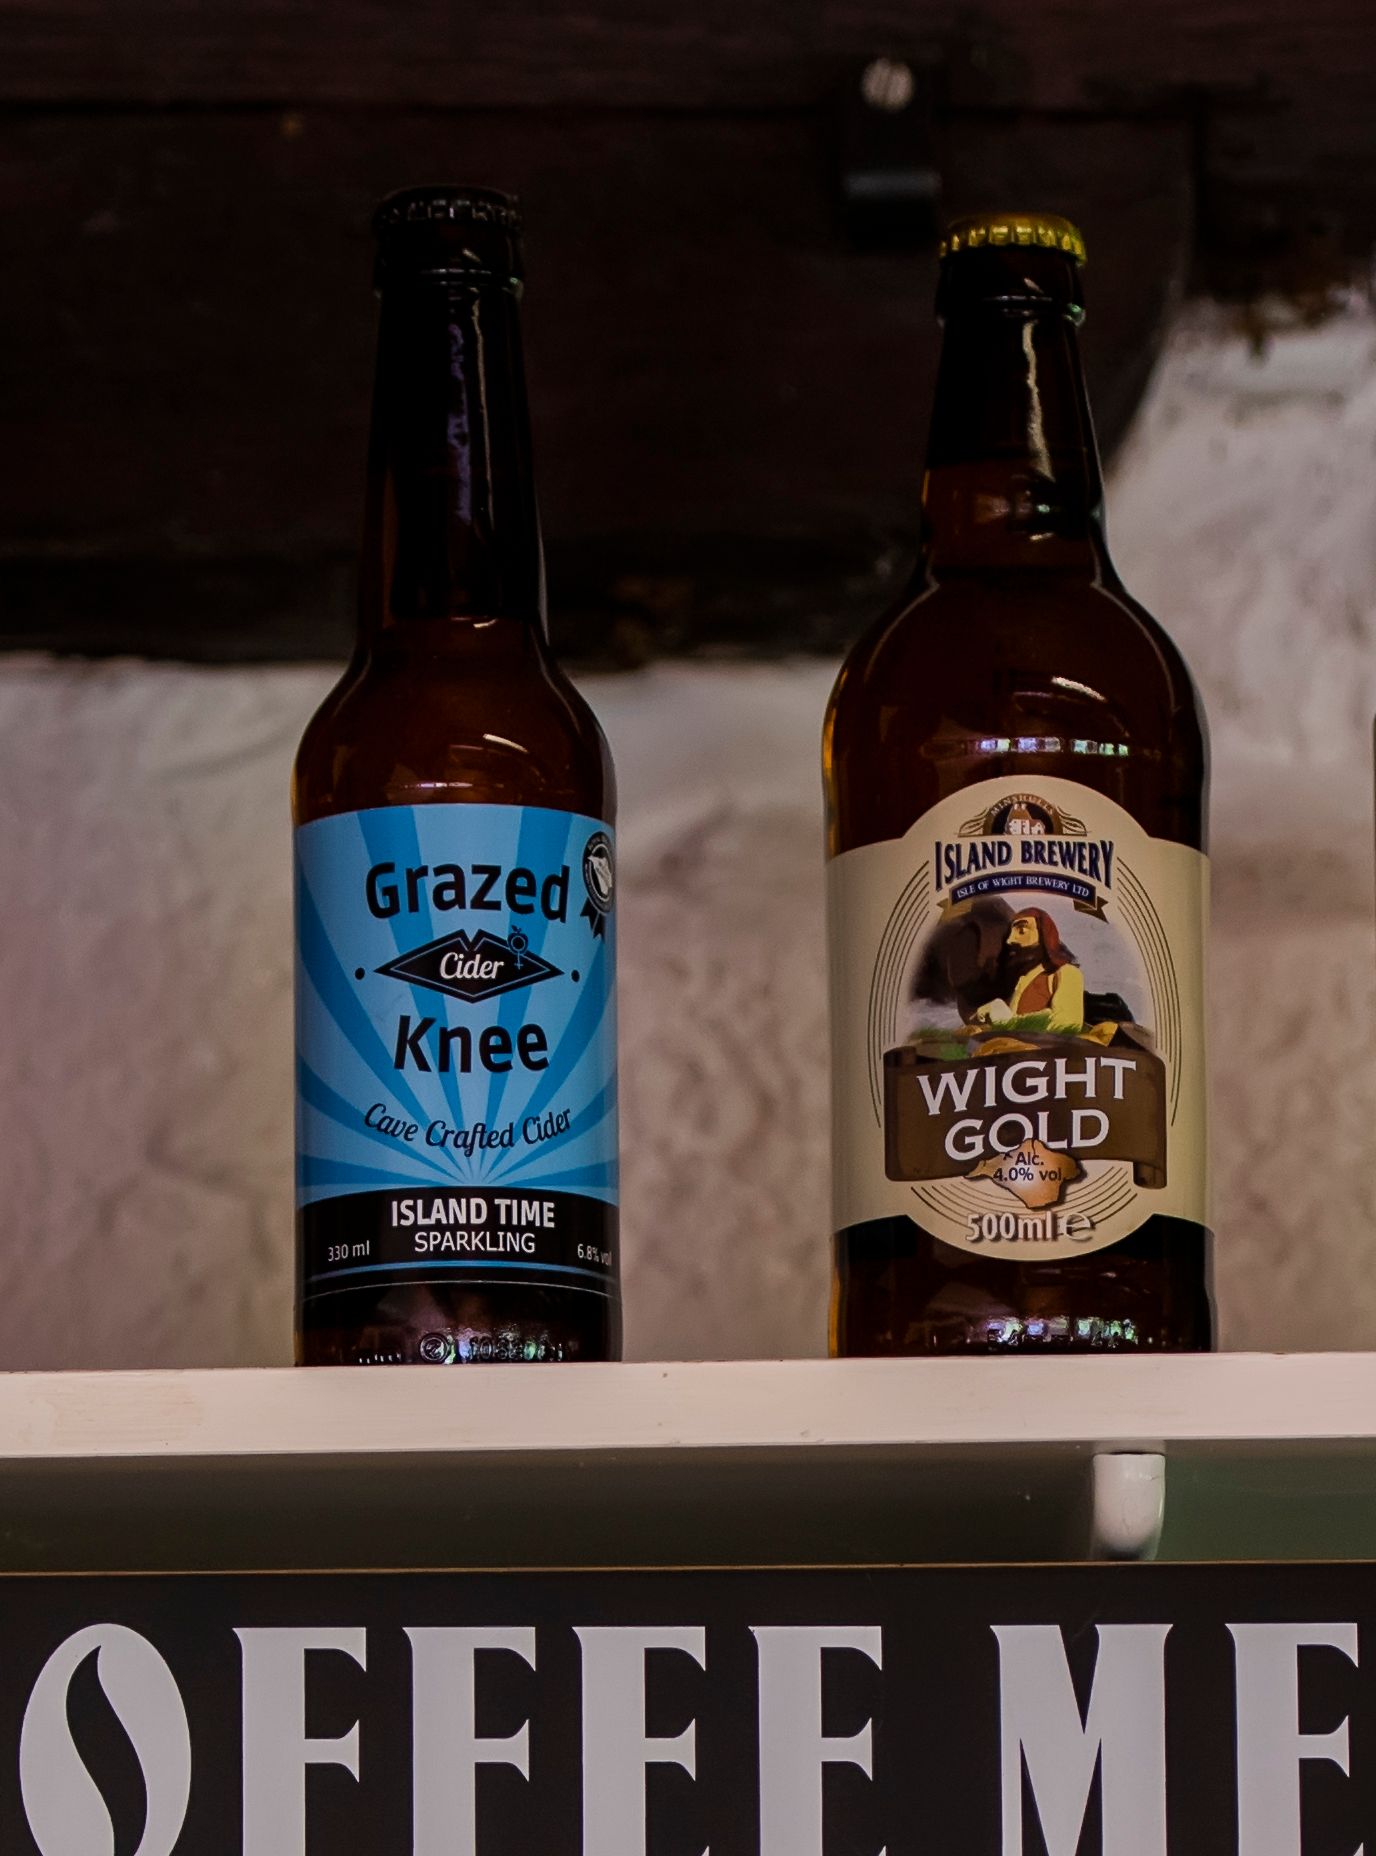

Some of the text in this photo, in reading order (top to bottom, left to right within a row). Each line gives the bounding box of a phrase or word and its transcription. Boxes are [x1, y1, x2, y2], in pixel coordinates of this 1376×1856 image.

[935, 840, 1115, 892] ISLAND BREWERY
[366, 862, 570, 924] Grazed
[956, 876, 1090, 899] ISLE OF WIGHT BREWERY LTD
[439, 951, 505, 980] Cider
[394, 1014, 550, 1074] Knee
[916, 1056, 1137, 1117] WIGHT
[364, 1102, 571, 1158] Cave Crafted Cider
[944, 1109, 1110, 1161] GOLD
[1015, 1151, 1044, 1166] Alc.
[993, 1167, 1034, 1182] 4.0%
[391, 1198, 556, 1228] ISLAND TIME
[327, 1240, 370, 1262] 330 ml
[414, 1231, 536, 1253] SPARKLING
[577, 1243, 600, 1262] 6.8%
